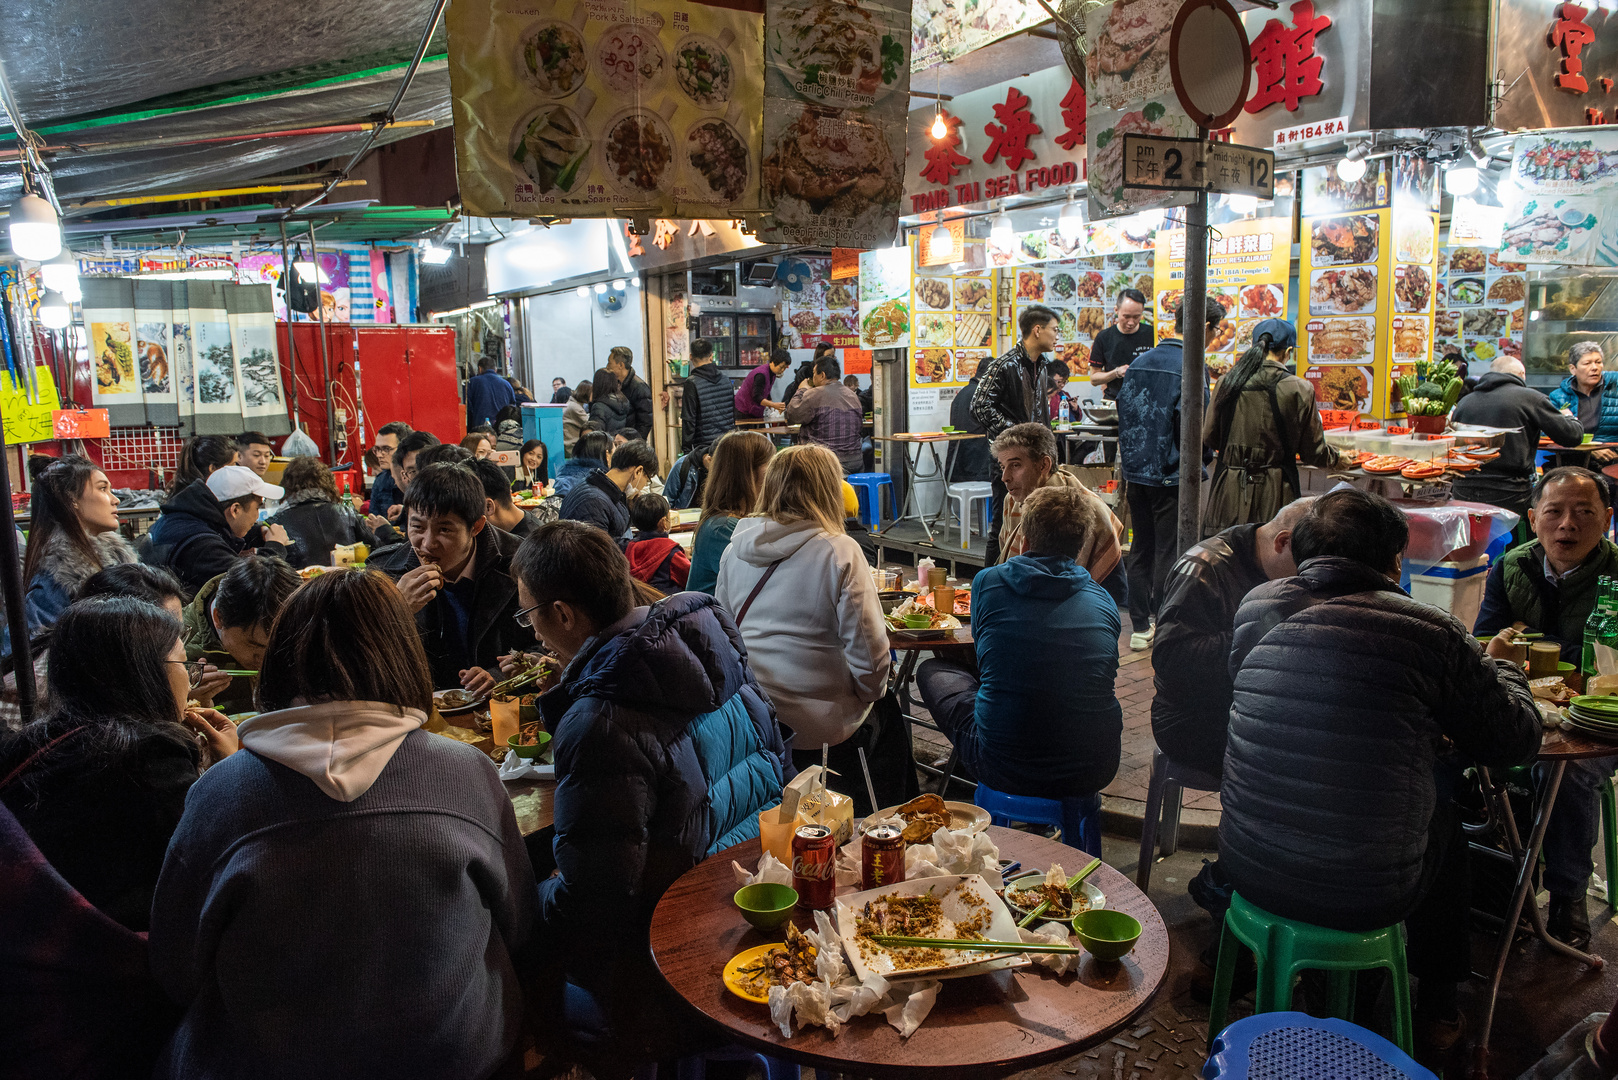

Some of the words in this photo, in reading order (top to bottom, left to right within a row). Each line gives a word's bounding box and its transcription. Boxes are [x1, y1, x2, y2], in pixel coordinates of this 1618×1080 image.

[589, 11, 609, 21] Pork
[611, 14, 618, 22] &
[620, 14, 645, 24] Salted
[646, 17, 662, 26] Fish
[673, 22, 690, 32] Frog
[1552, 3, 1596, 94] 堂
[1244, 0, 1333, 115] 館
[795, 82, 823, 96] Garlic
[824, 86, 843, 98] Chili
[845, 90, 875, 104] Prawns
[1136, 145, 1155, 157] pm
[1213, 152, 1246, 165] midnight
[1132, 159, 1159, 179] 下午
[1164, 148, 1183, 180] 2
[1248, 158, 1269, 188] 12
[1220, 165, 1241, 184] 午夜
[910, 189, 951, 214] TONG
[955, 181, 981, 205] TAI
[985, 173, 1021, 200] SEA
[1026, 162, 1077, 192] FOOD
[514, 194, 538, 203] Duck
[540, 194, 556, 205] Leg
[587, 194, 612, 205] Spare
[613, 194, 630, 204] Ribs
[782, 226, 807, 238] Deep
[808, 227, 829, 238] Fried
[830, 228, 853, 241] Spicy
[853, 230, 877, 241] Crabs
[1228, 254, 1273, 264] RESTAURANT
[871, 853, 884, 887] 王老
